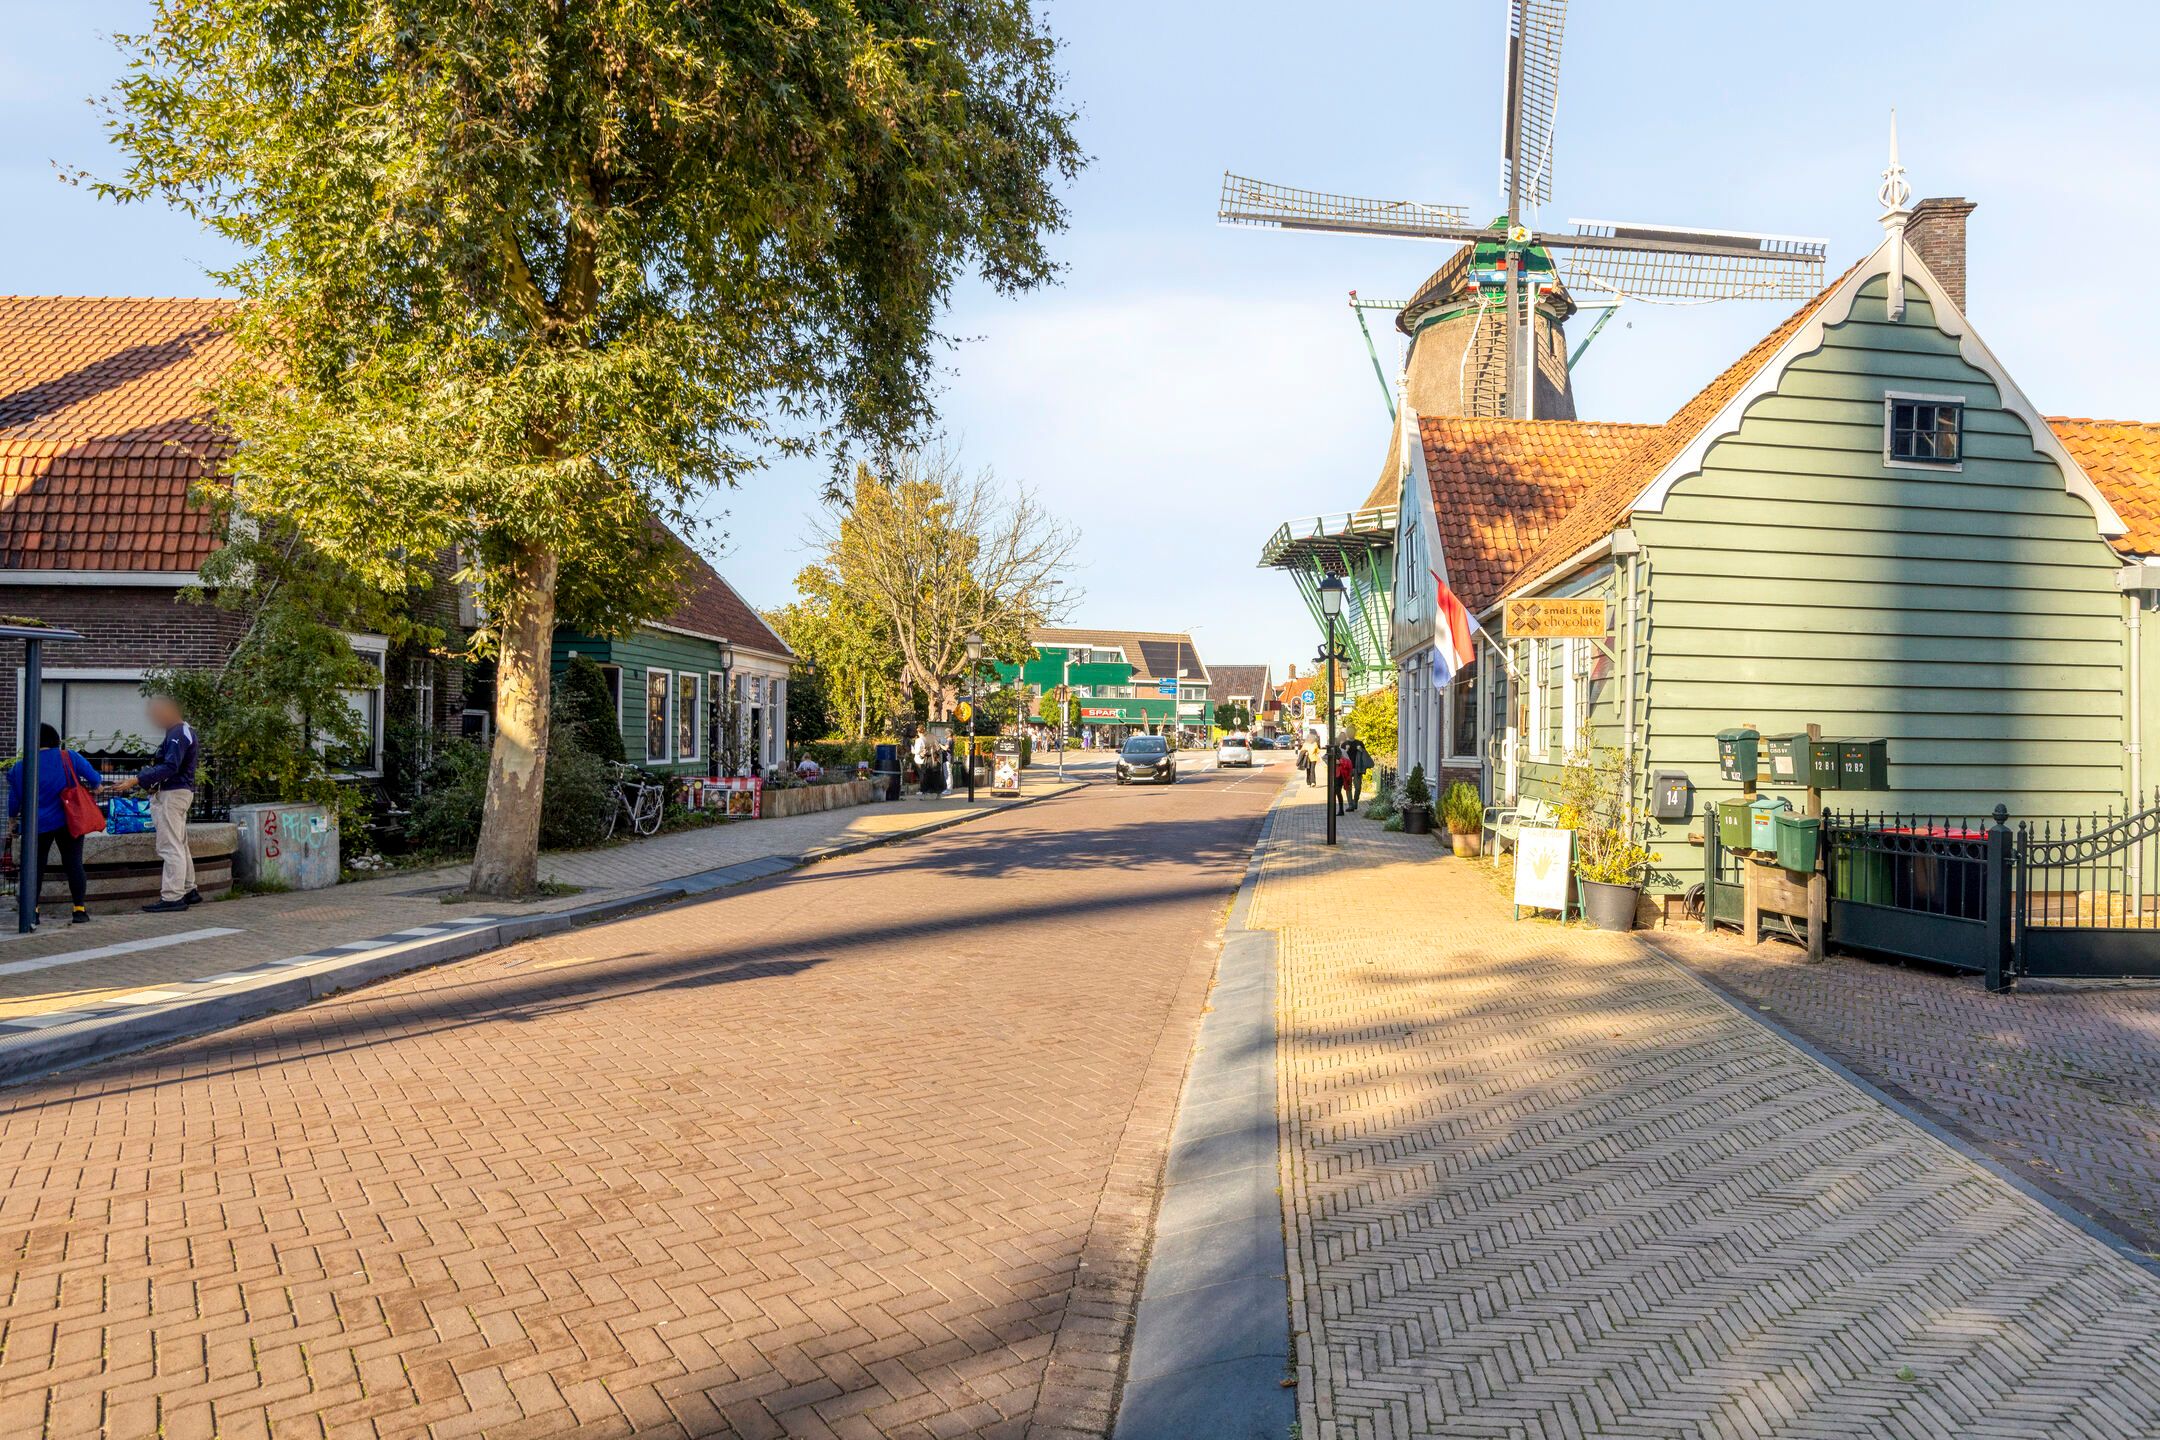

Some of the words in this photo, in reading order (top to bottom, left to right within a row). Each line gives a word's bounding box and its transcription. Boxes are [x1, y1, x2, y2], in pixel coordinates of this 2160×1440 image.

[1544, 606, 1578, 615] smells
[1582, 606, 1601, 615] like
[1544, 615, 1601, 627] chocolate
[1089, 709, 1117, 717] SPAR
[1666, 790, 1678, 806] 14
